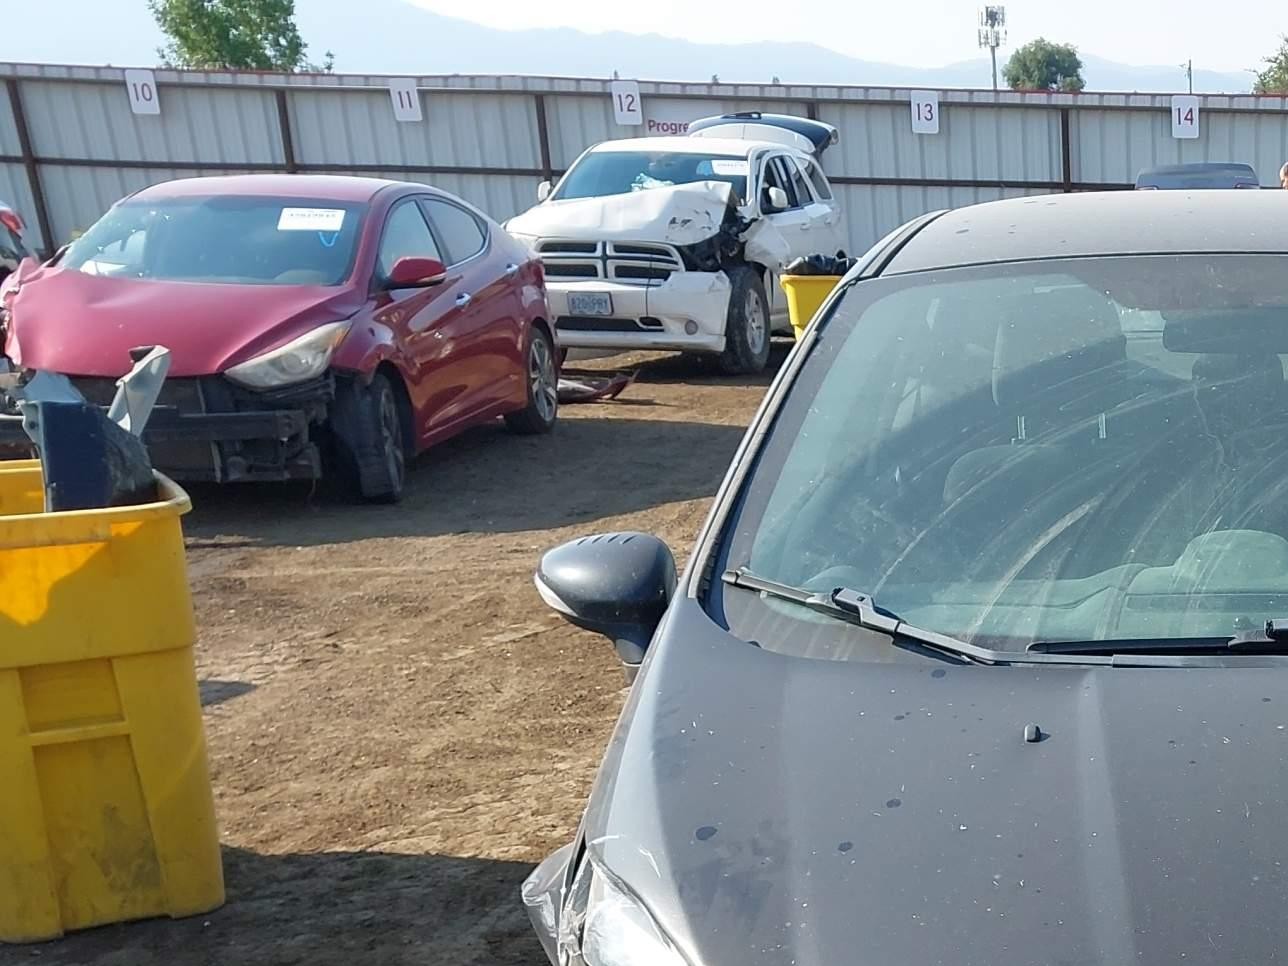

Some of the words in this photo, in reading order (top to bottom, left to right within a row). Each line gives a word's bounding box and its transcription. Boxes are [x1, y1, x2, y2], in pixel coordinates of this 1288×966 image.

[132, 82, 153, 103] 10
[397, 90, 413, 109] 11
[617, 93, 637, 113] 12
[916, 102, 934, 122] 13
[1177, 106, 1195, 126] 14
